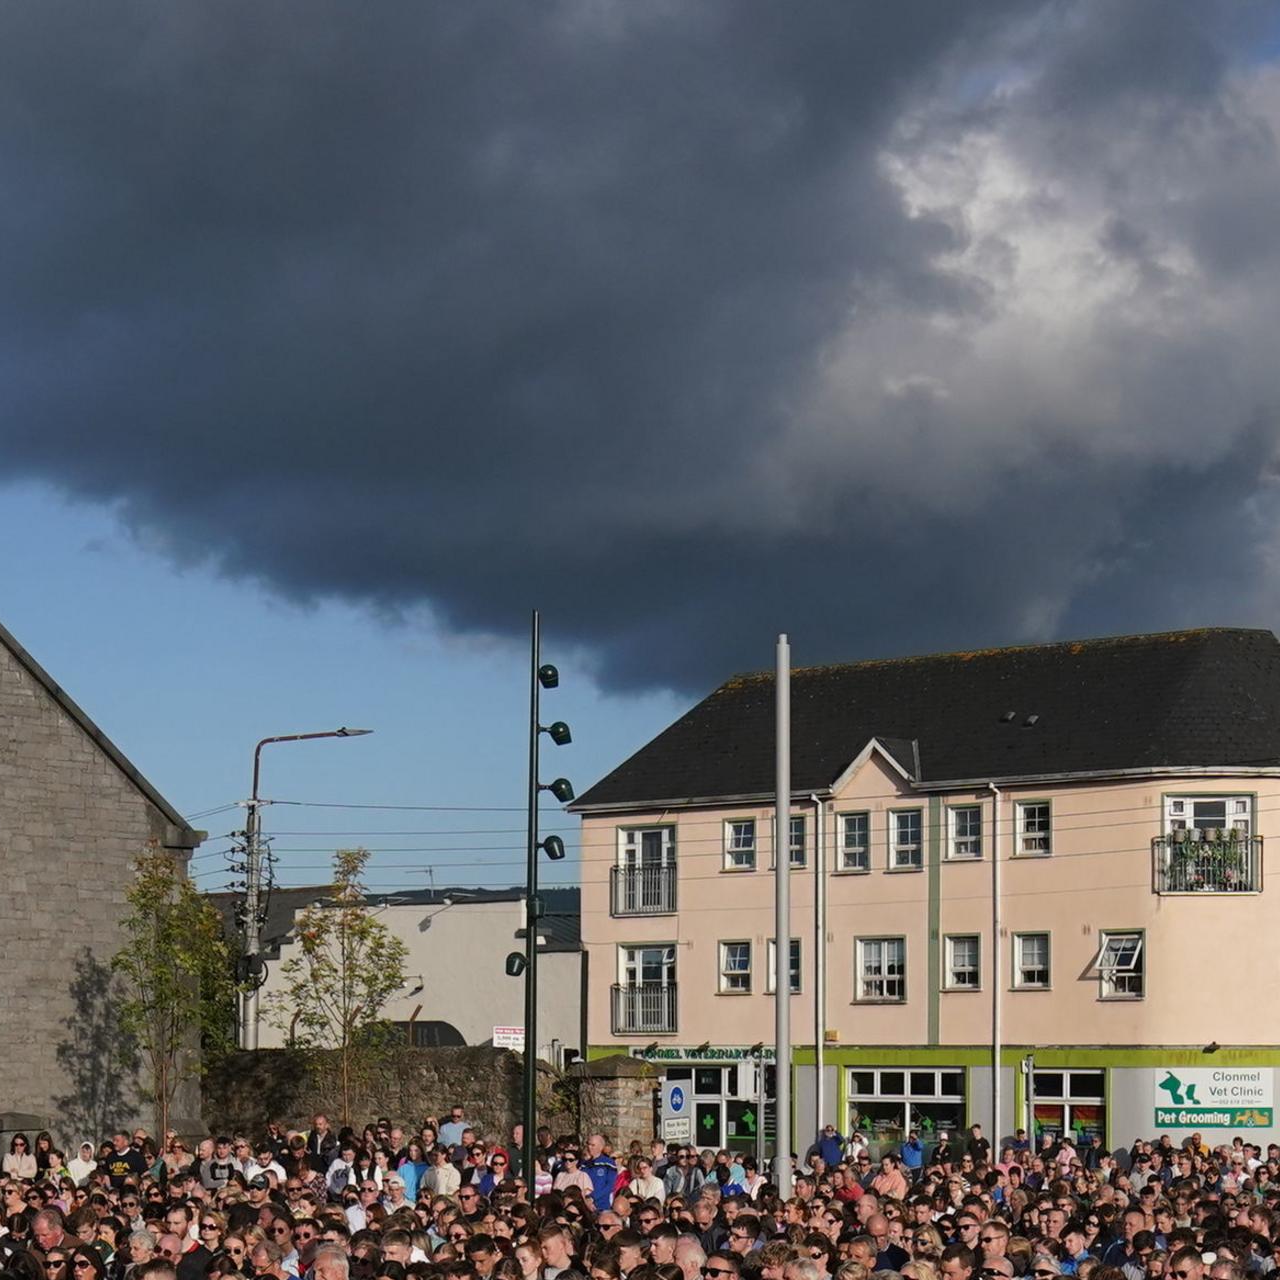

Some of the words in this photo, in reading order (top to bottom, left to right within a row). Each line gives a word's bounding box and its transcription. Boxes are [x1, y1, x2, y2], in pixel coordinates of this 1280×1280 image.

[1212, 1072, 1260, 1081] Clonmel
[1209, 1086, 1227, 1096] Vet
[1231, 1086, 1263, 1096] Clinic
[1158, 1111, 1176, 1123] Pet
[1179, 1111, 1230, 1125] Grooming
